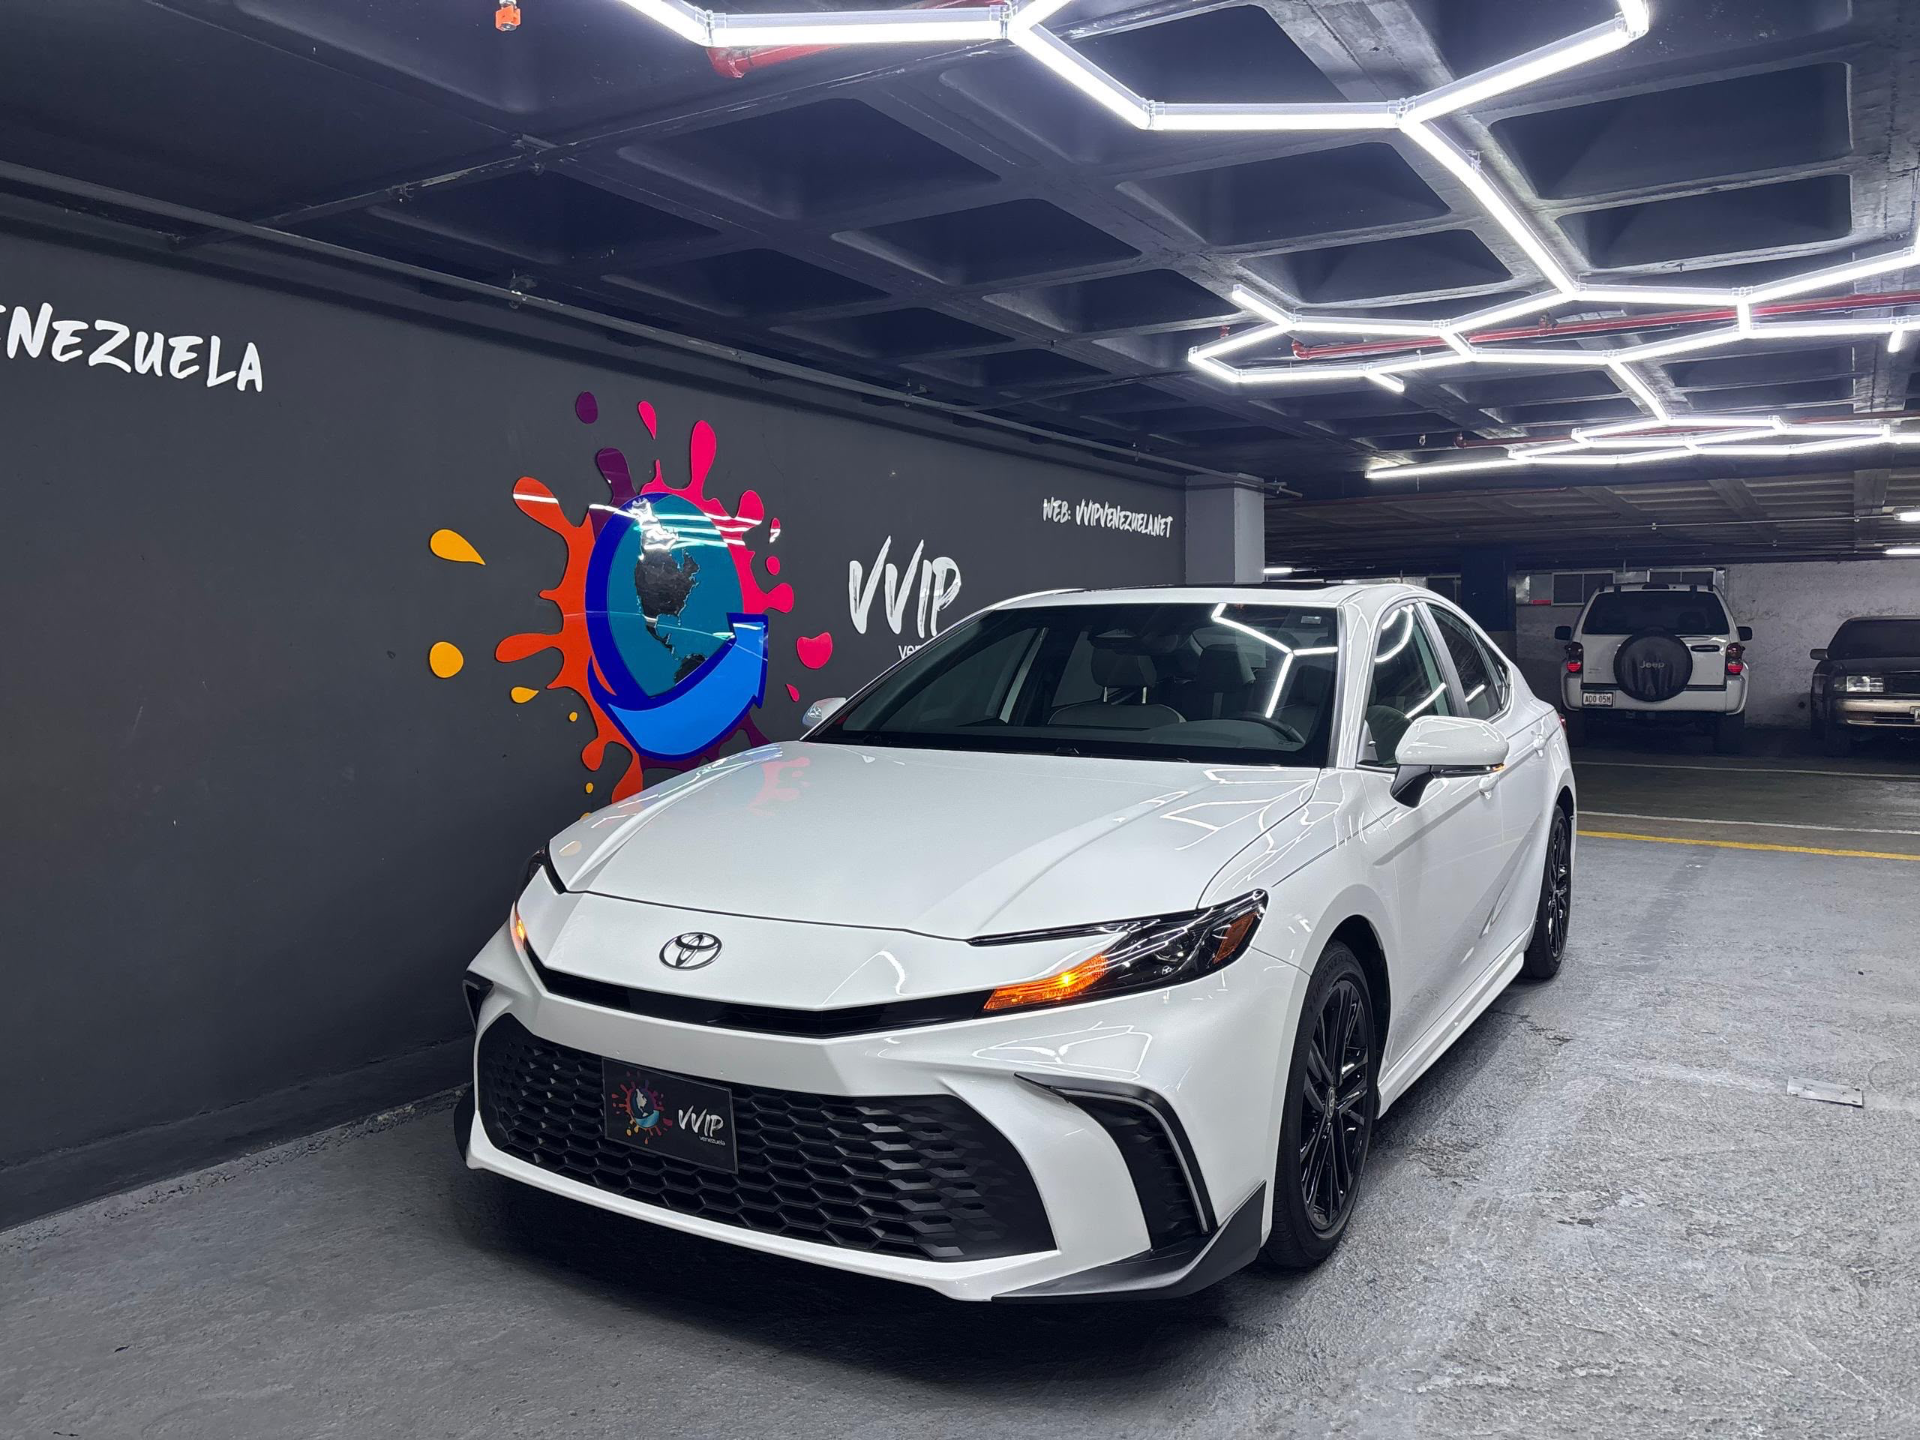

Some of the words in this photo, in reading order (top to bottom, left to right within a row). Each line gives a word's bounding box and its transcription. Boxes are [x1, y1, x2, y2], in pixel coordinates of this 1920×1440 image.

[0, 302, 263, 393] NEZUELA
[1043, 496, 1071, 524] WEB:
[848, 535, 962, 639] VVIP
[1640, 660, 1665, 669] Jeep
[678, 1105, 724, 1137] VVIP
